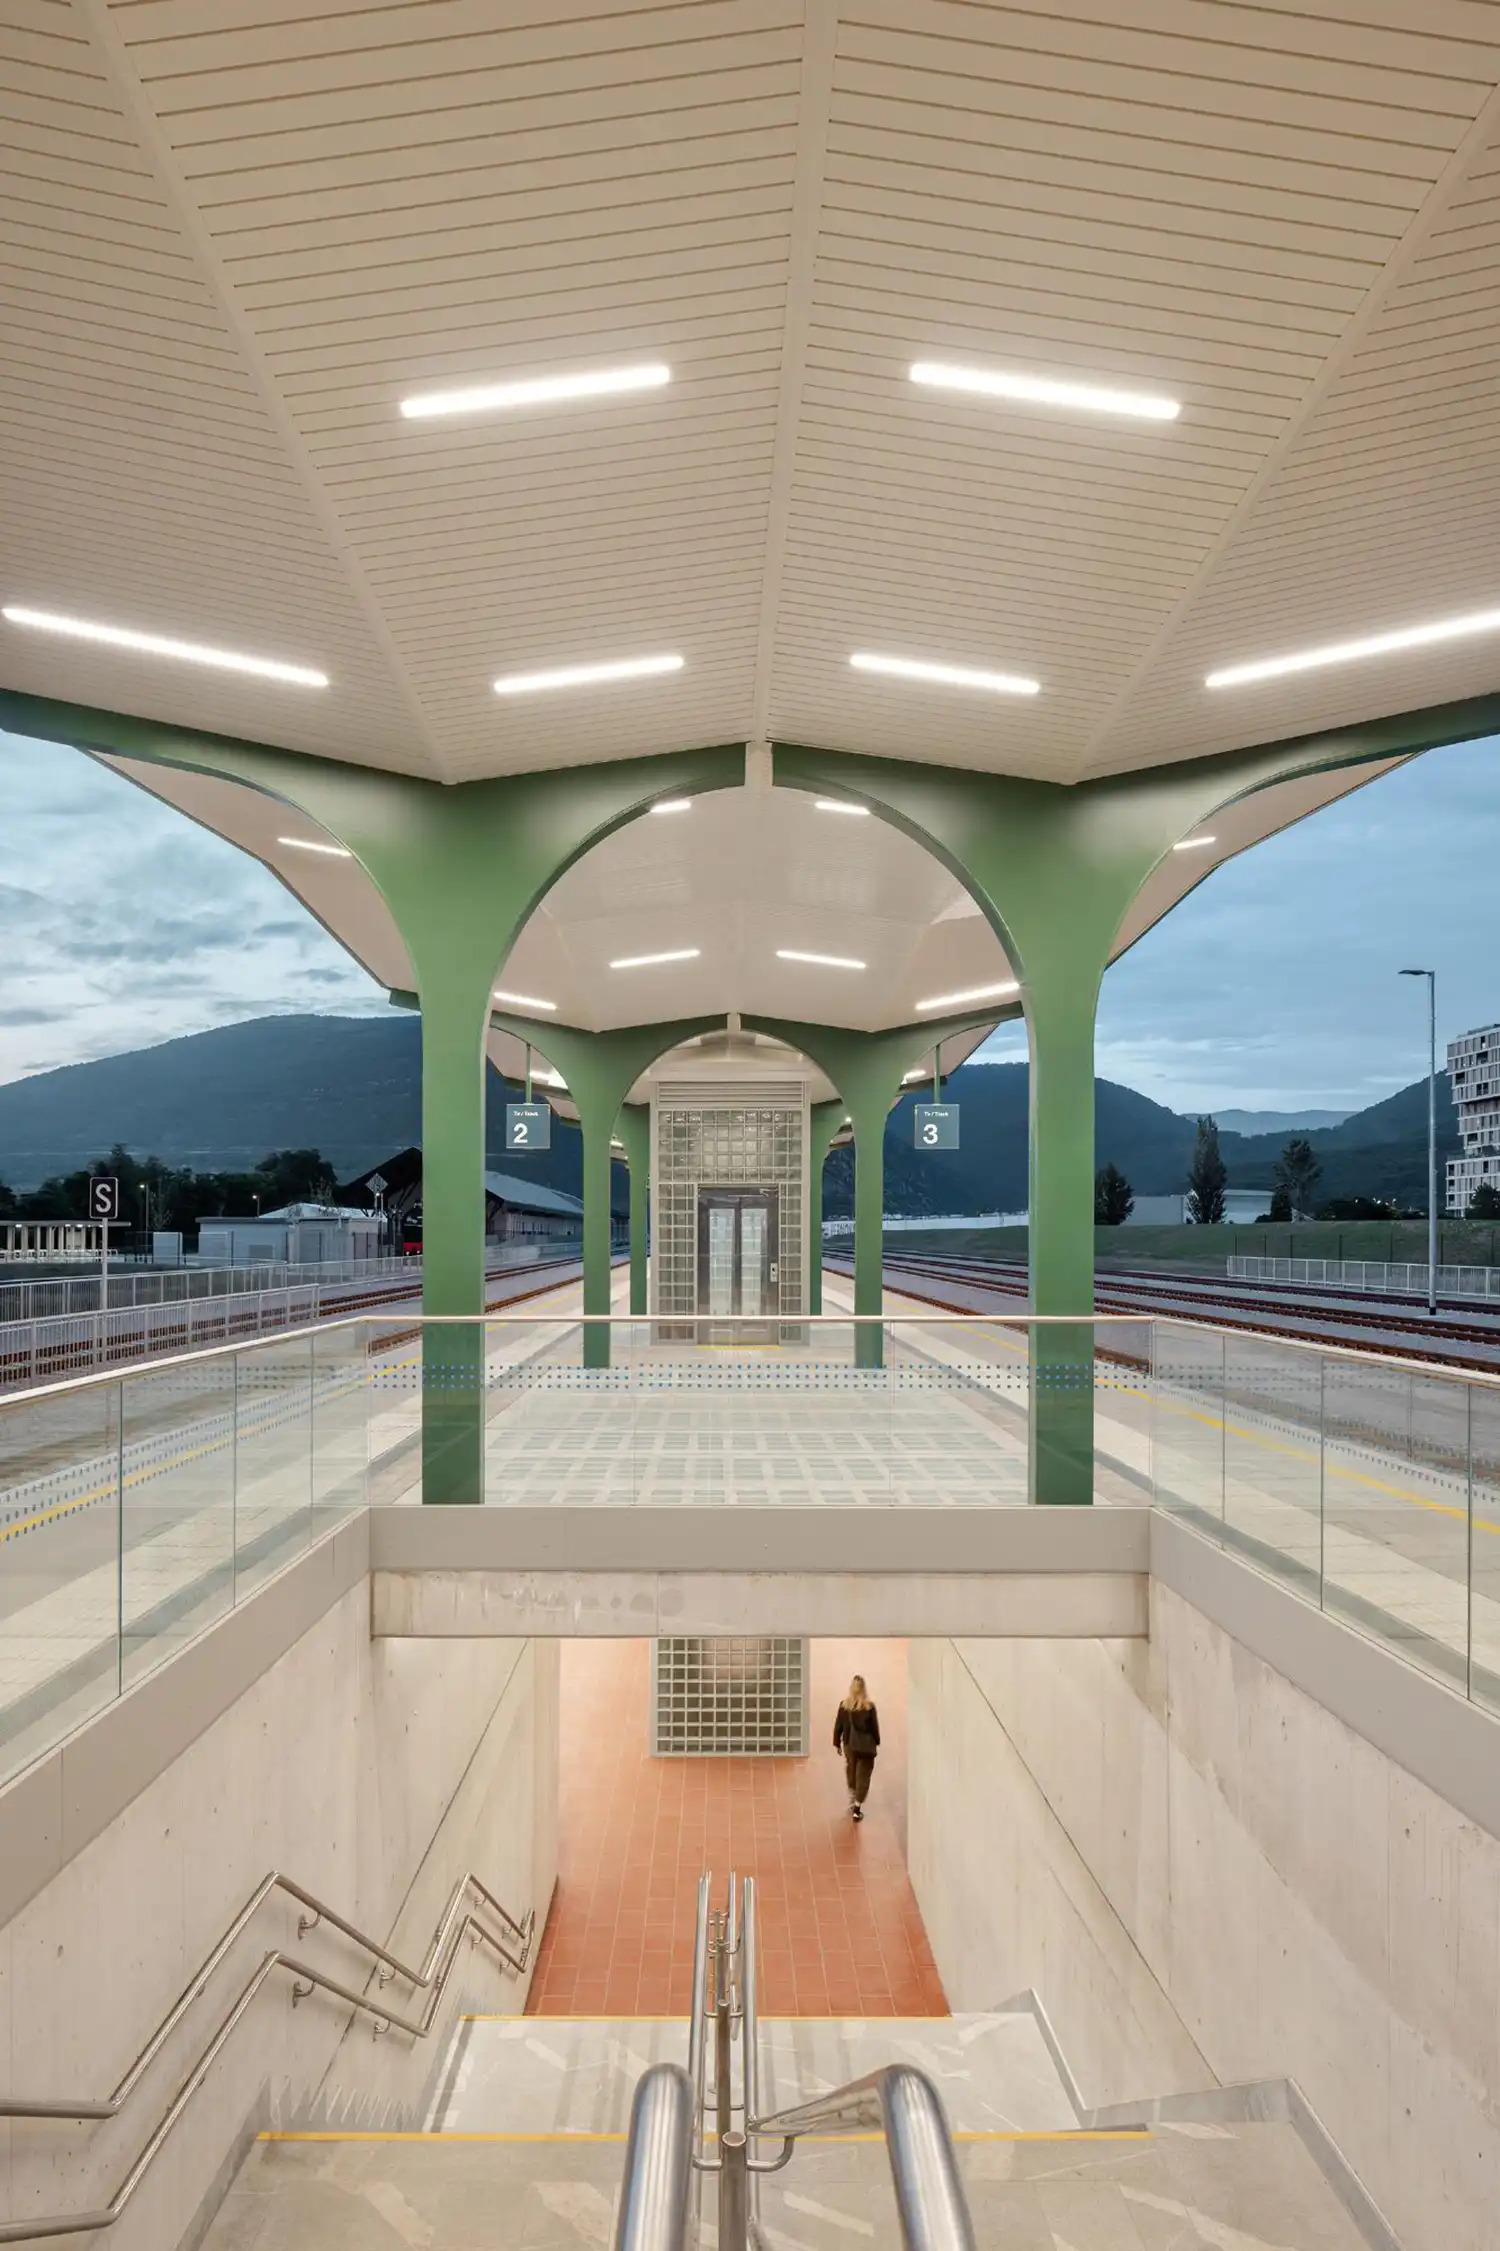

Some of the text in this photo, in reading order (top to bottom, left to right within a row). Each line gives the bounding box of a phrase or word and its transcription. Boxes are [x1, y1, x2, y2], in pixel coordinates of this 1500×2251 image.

[513, 1123, 528, 1143] 2
[923, 1124, 938, 1144] 3
[96, 1183, 111, 1212] S
